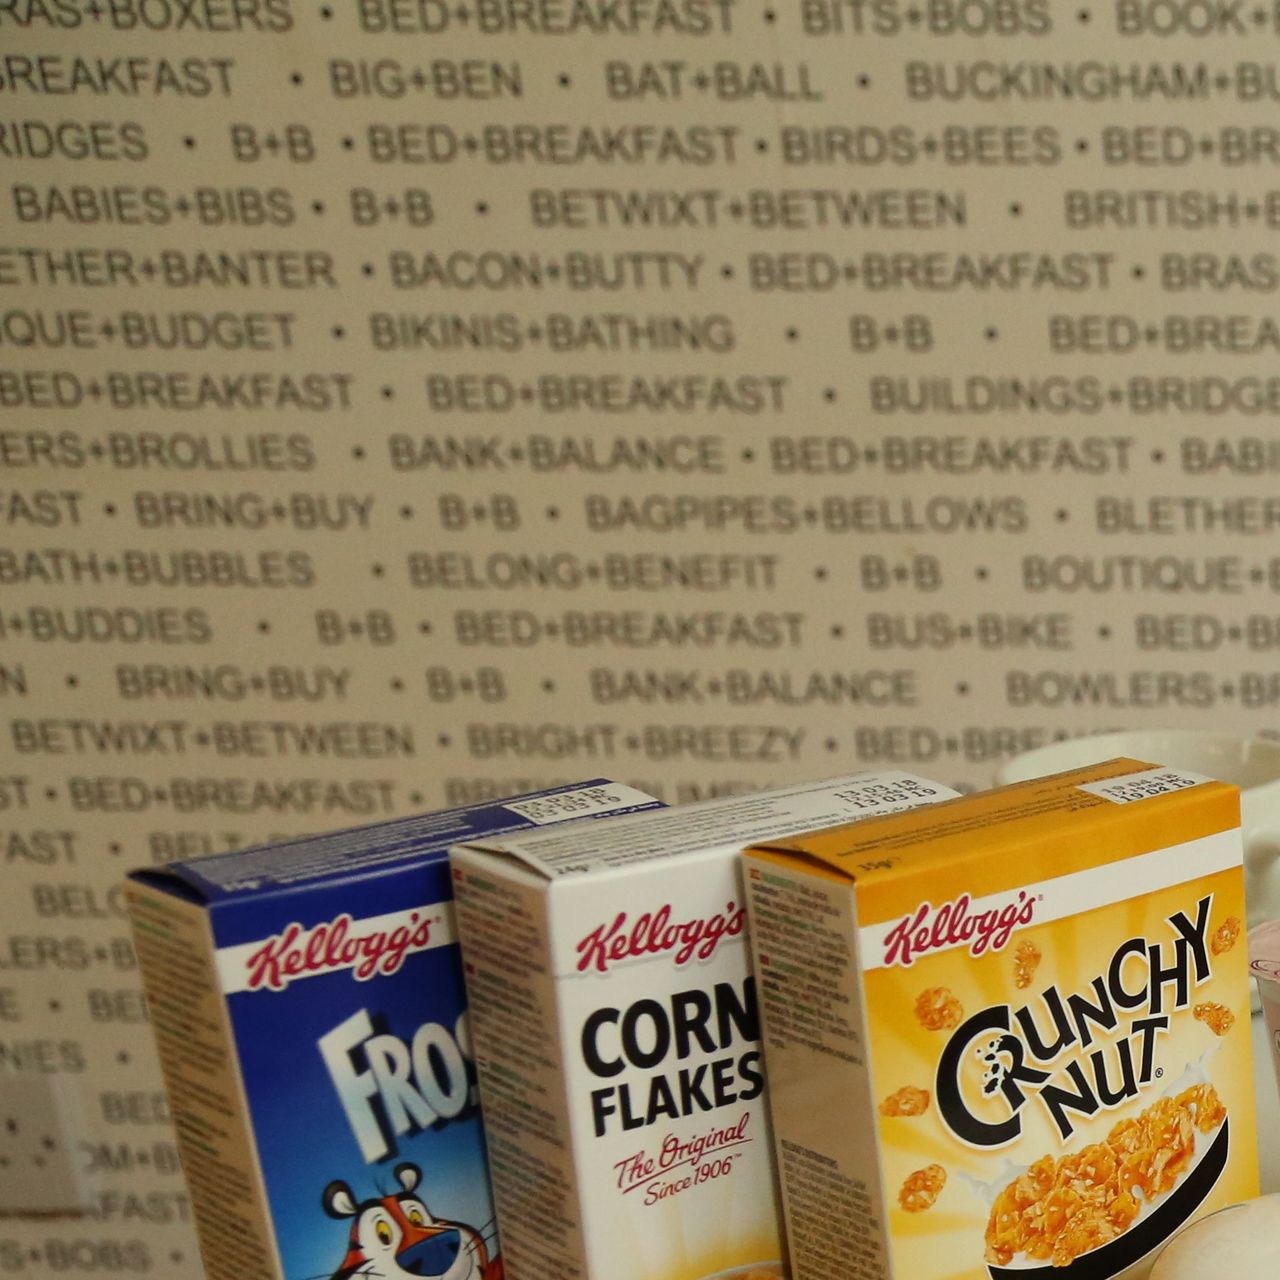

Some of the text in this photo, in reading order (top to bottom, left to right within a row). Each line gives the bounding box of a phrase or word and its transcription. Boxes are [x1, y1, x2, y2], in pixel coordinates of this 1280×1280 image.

[357, 0, 736, 37] BED+BREAKFAST
[802, 0, 1052, 37] BITS+BOBS
[0, 53, 235, 99] REAKFAST
[327, 58, 524, 100] BIG+BEN
[604, 60, 823, 102] BAT+BALL
[228, 122, 317, 164] B+B
[366, 123, 739, 166] BED+BREAKFAST
[779, 125, 1062, 166] BIRDS+BEES
[10, 183, 297, 227] BABIES+BIBS
[348, 187, 436, 228] B+B
[528, 188, 968, 230] BETWIXT+BETWEEN
[388, 250, 704, 291] BACON+BUTTY
[748, 252, 1114, 292] BED+BREAKFAST
[368, 312, 736, 353] BIKINIS+BATHING
[848, 314, 934, 354] B+B
[425, 374, 787, 415] BED+BREAKFAST
[387, 433, 723, 474] BANK+BALANCE
[769, 436, 1132, 475] BED+BREAKFAST
[132, 491, 374, 531] BRING+BUY
[437, 493, 521, 532] B+B
[859, 554, 943, 592] B+B
[314, 609, 397, 646] B+B
[453, 610, 803, 649] BED+BREAKFAST
[866, 612, 1070, 650] BUS+BIKE
[114, 663, 350, 702] BRING+BUY
[425, 666, 507, 704] B+B
[246, 912, 432, 989] Kellogg's
[577, 901, 746, 972] Kellogg's
[883, 891, 1036, 966] Kellogg's
[580, 975, 760, 1079] CORN
[937, 895, 1214, 1146] CRUNCHY
[589, 1051, 765, 1138] FLAKES
[1038, 1017, 1168, 1141] NUT
[613, 1111, 751, 1190] The Original
[643, 1176, 692, 1207] Since
